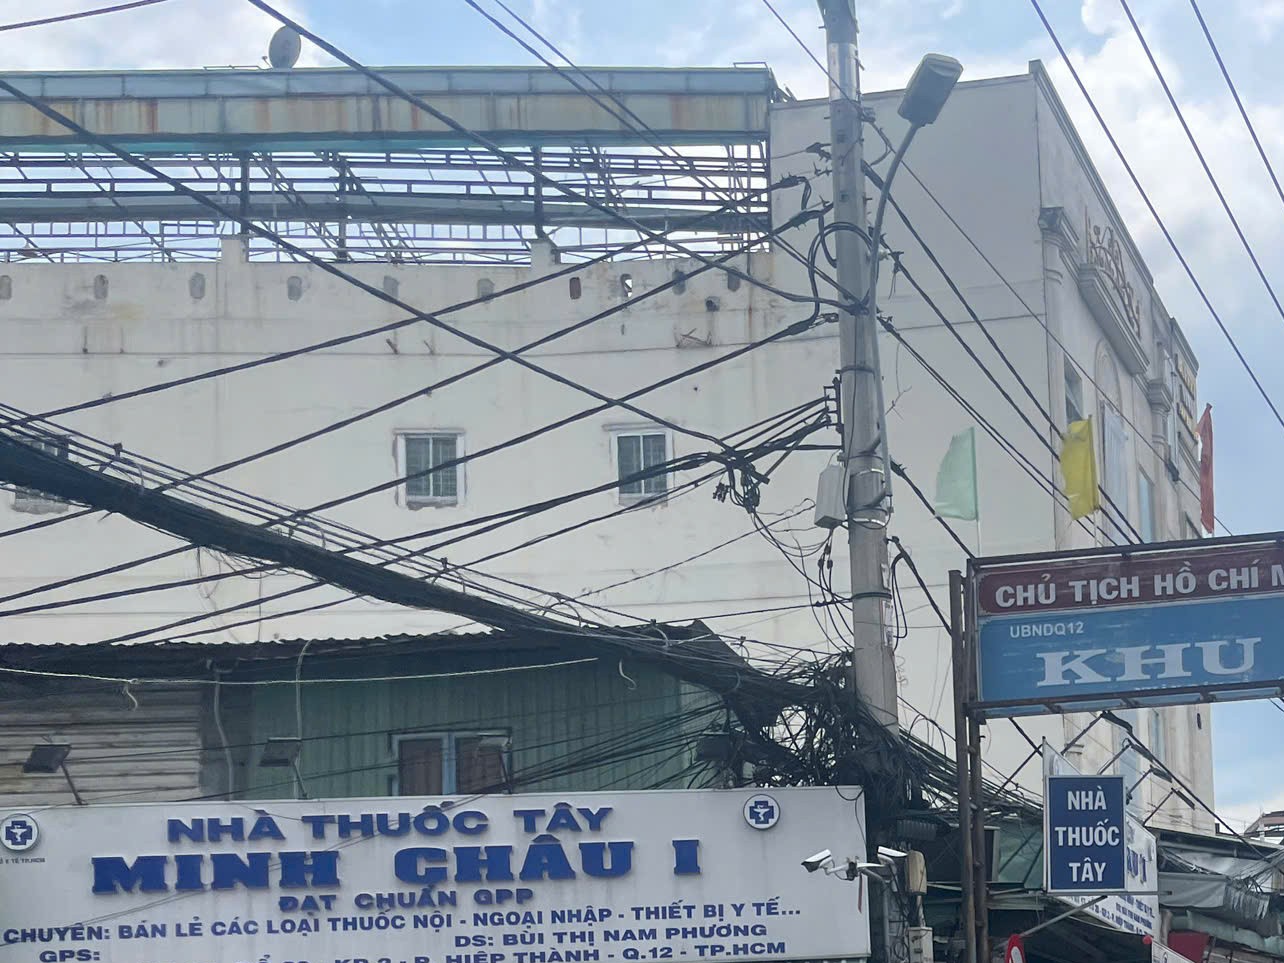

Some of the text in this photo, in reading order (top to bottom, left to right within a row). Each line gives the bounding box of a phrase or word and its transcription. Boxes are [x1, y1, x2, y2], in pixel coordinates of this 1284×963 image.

[995, 573, 1056, 609] CHỦ
[1069, 572, 1140, 608] TỊCH
[1153, 561, 1197, 598] HỒ
[1207, 562, 1260, 592] CHÍ
[1009, 620, 1084, 639] UBNDQ12
[1035, 634, 1263, 689] KHU
[1067, 785, 1107, 811] NHÀ
[168, 800, 614, 843] NHÀ THUỐC TÂY
[1054, 818, 1120, 847] THUỐC
[91, 833, 701, 896] MINH CHÂU I
[1068, 857, 1106, 882] TÂY
[278, 884, 534, 917] ĐẠT CHUẨN GPP
[3, 922, 110, 945] CHUYÊN:
[118, 920, 167, 939] BÁN
[175, 916, 202, 937] LẺ
[210, 915, 259, 936] CÁC
[266, 917, 320, 937] LOẠI
[327, 907, 406, 932] THUỐC
[413, 910, 452, 933] NỘI
[473, 910, 543, 930] NGOẠI
[551, 904, 613, 926] NHẬP
[631, 899, 696, 921] THIẾT
[703, 904, 725, 921] BỊ
[732, 902, 745, 917] Y
[752, 896, 801, 917] TẾ...
[454, 923, 768, 948] DS: BÙI THỊ NAM PHƯƠNG
[39, 948, 101, 963] GPS:
[520, 947, 600, 963] THÀNH
[622, 947, 674, 962] Q.12
[694, 941, 787, 957] TP.HCM
